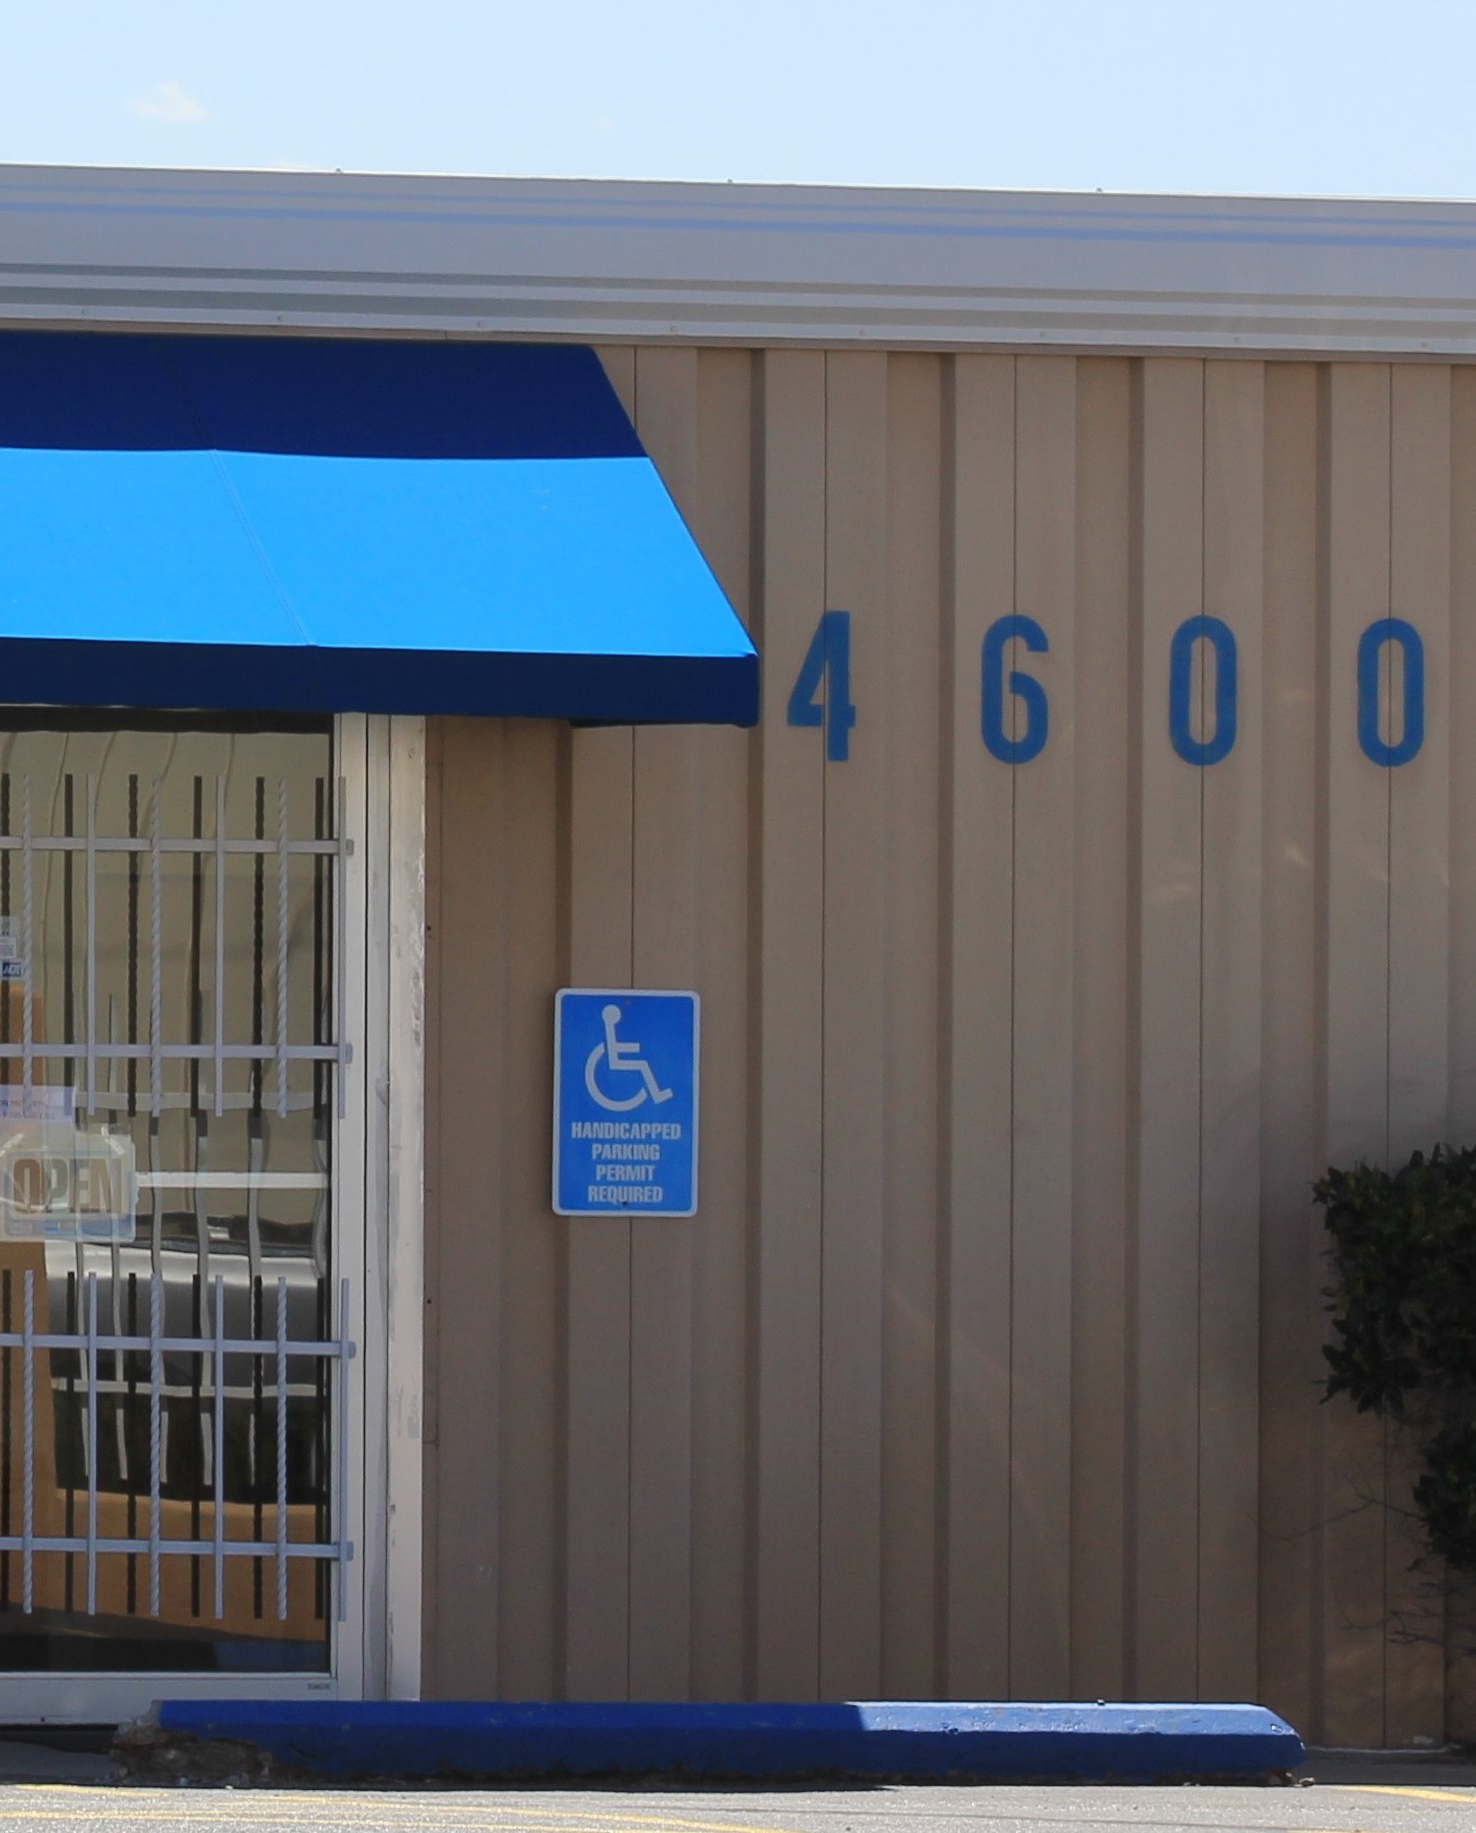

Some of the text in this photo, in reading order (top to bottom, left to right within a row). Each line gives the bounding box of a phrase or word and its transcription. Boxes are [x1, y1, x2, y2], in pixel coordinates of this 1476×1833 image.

[570, 1121, 681, 1140] HANDICAPPED
[591, 1143, 661, 1161] PARKING
[596, 1164, 656, 1181] PERMIT
[13, 1158, 124, 1213] OPEN
[587, 1186, 663, 1205] REQUIRED
